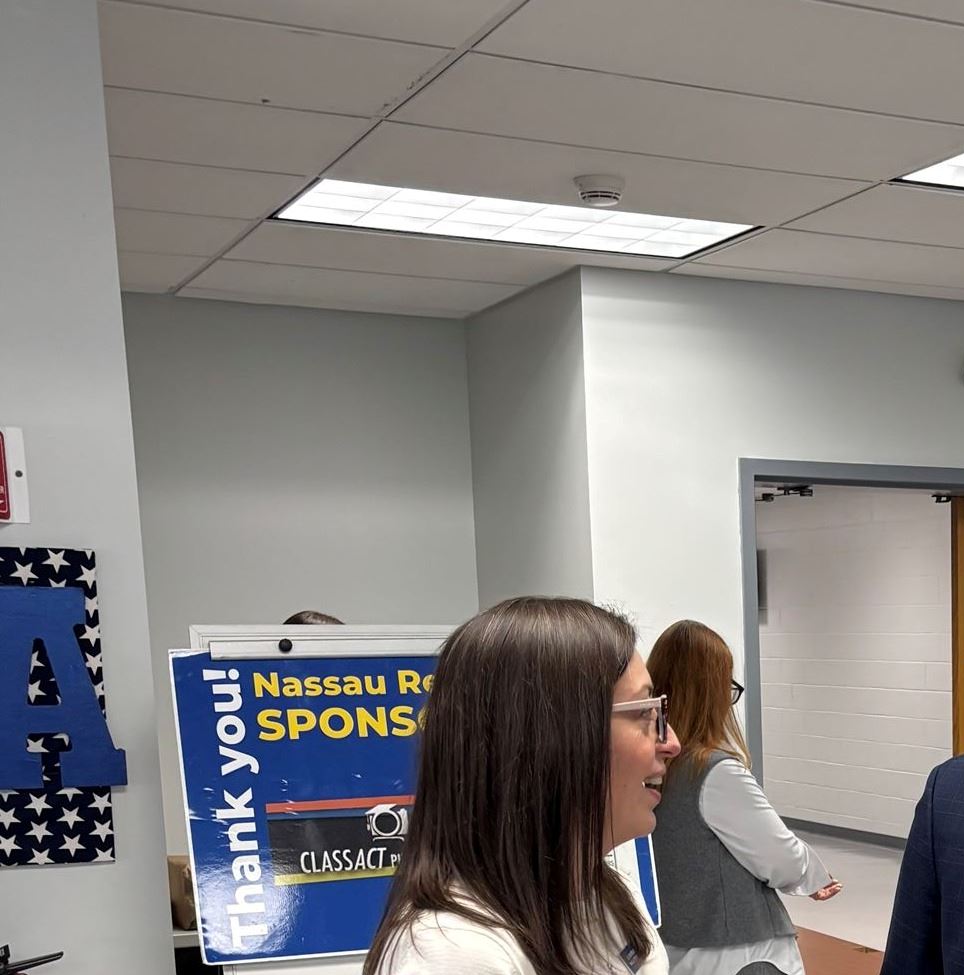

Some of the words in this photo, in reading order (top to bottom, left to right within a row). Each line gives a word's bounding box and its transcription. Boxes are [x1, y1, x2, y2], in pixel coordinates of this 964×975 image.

[0, 586, 128, 789] A
[202, 668, 261, 776] you!
[252, 671, 387, 698] Nassau
[257, 705, 428, 741] SPONS
[216, 787, 269, 950] Thank
